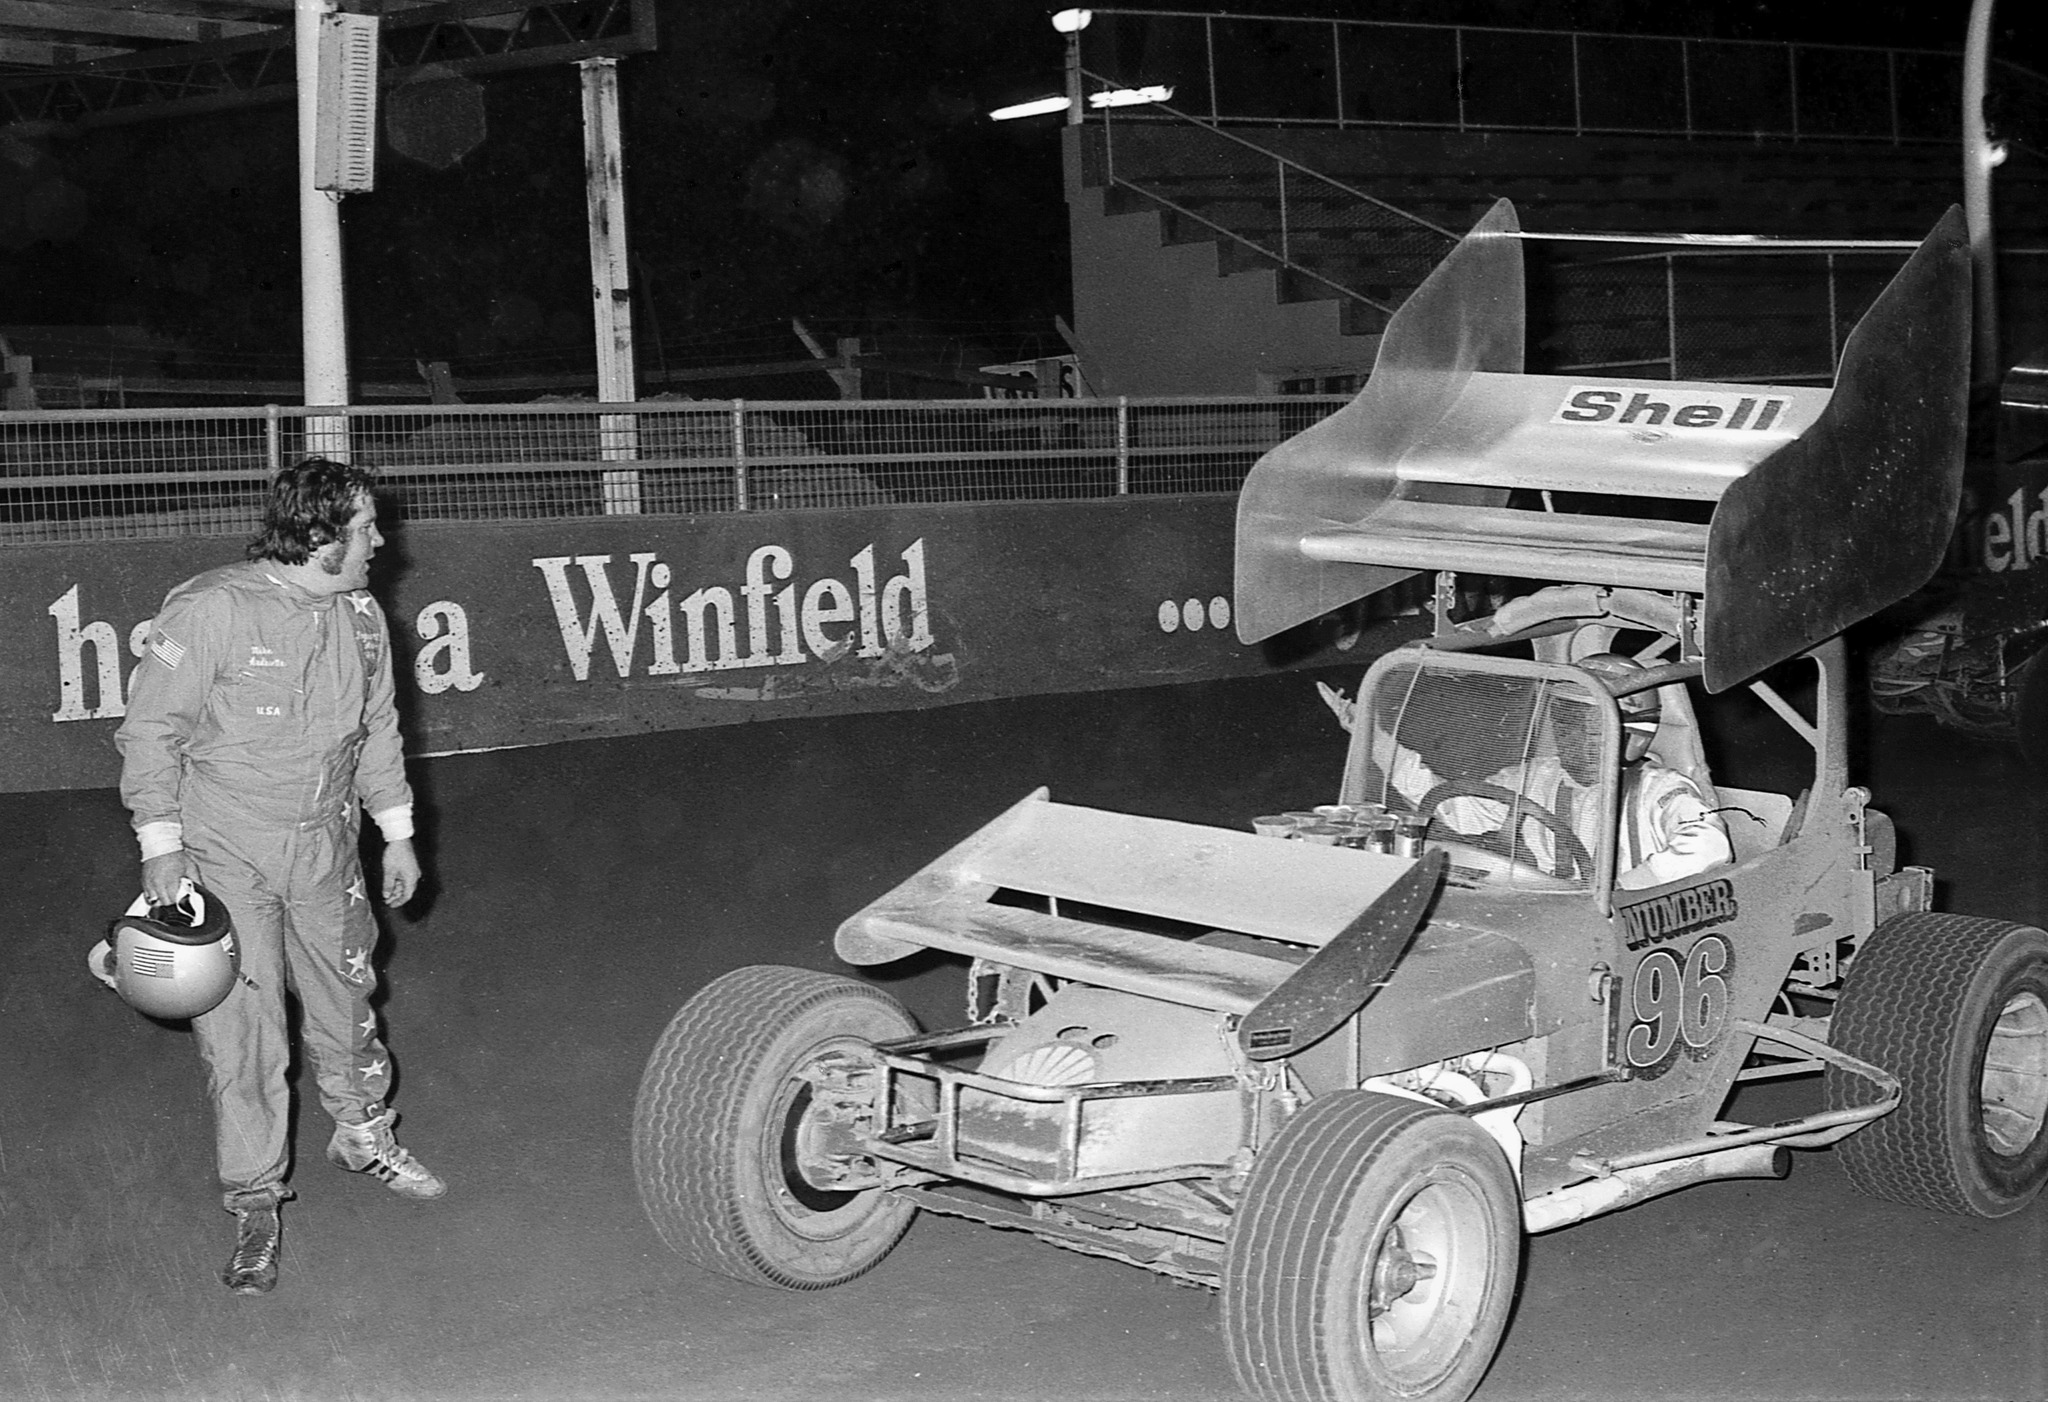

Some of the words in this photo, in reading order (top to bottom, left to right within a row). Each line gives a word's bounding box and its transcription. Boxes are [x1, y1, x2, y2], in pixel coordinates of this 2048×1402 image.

[1561, 390, 1784, 430] Shell
[414, 600, 484, 695] a
[532, 537, 935, 681] Winfield
[256, 705, 281, 716] USA
[1620, 879, 1738, 951] NUMBER
[1627, 933, 1735, 1077] 96
